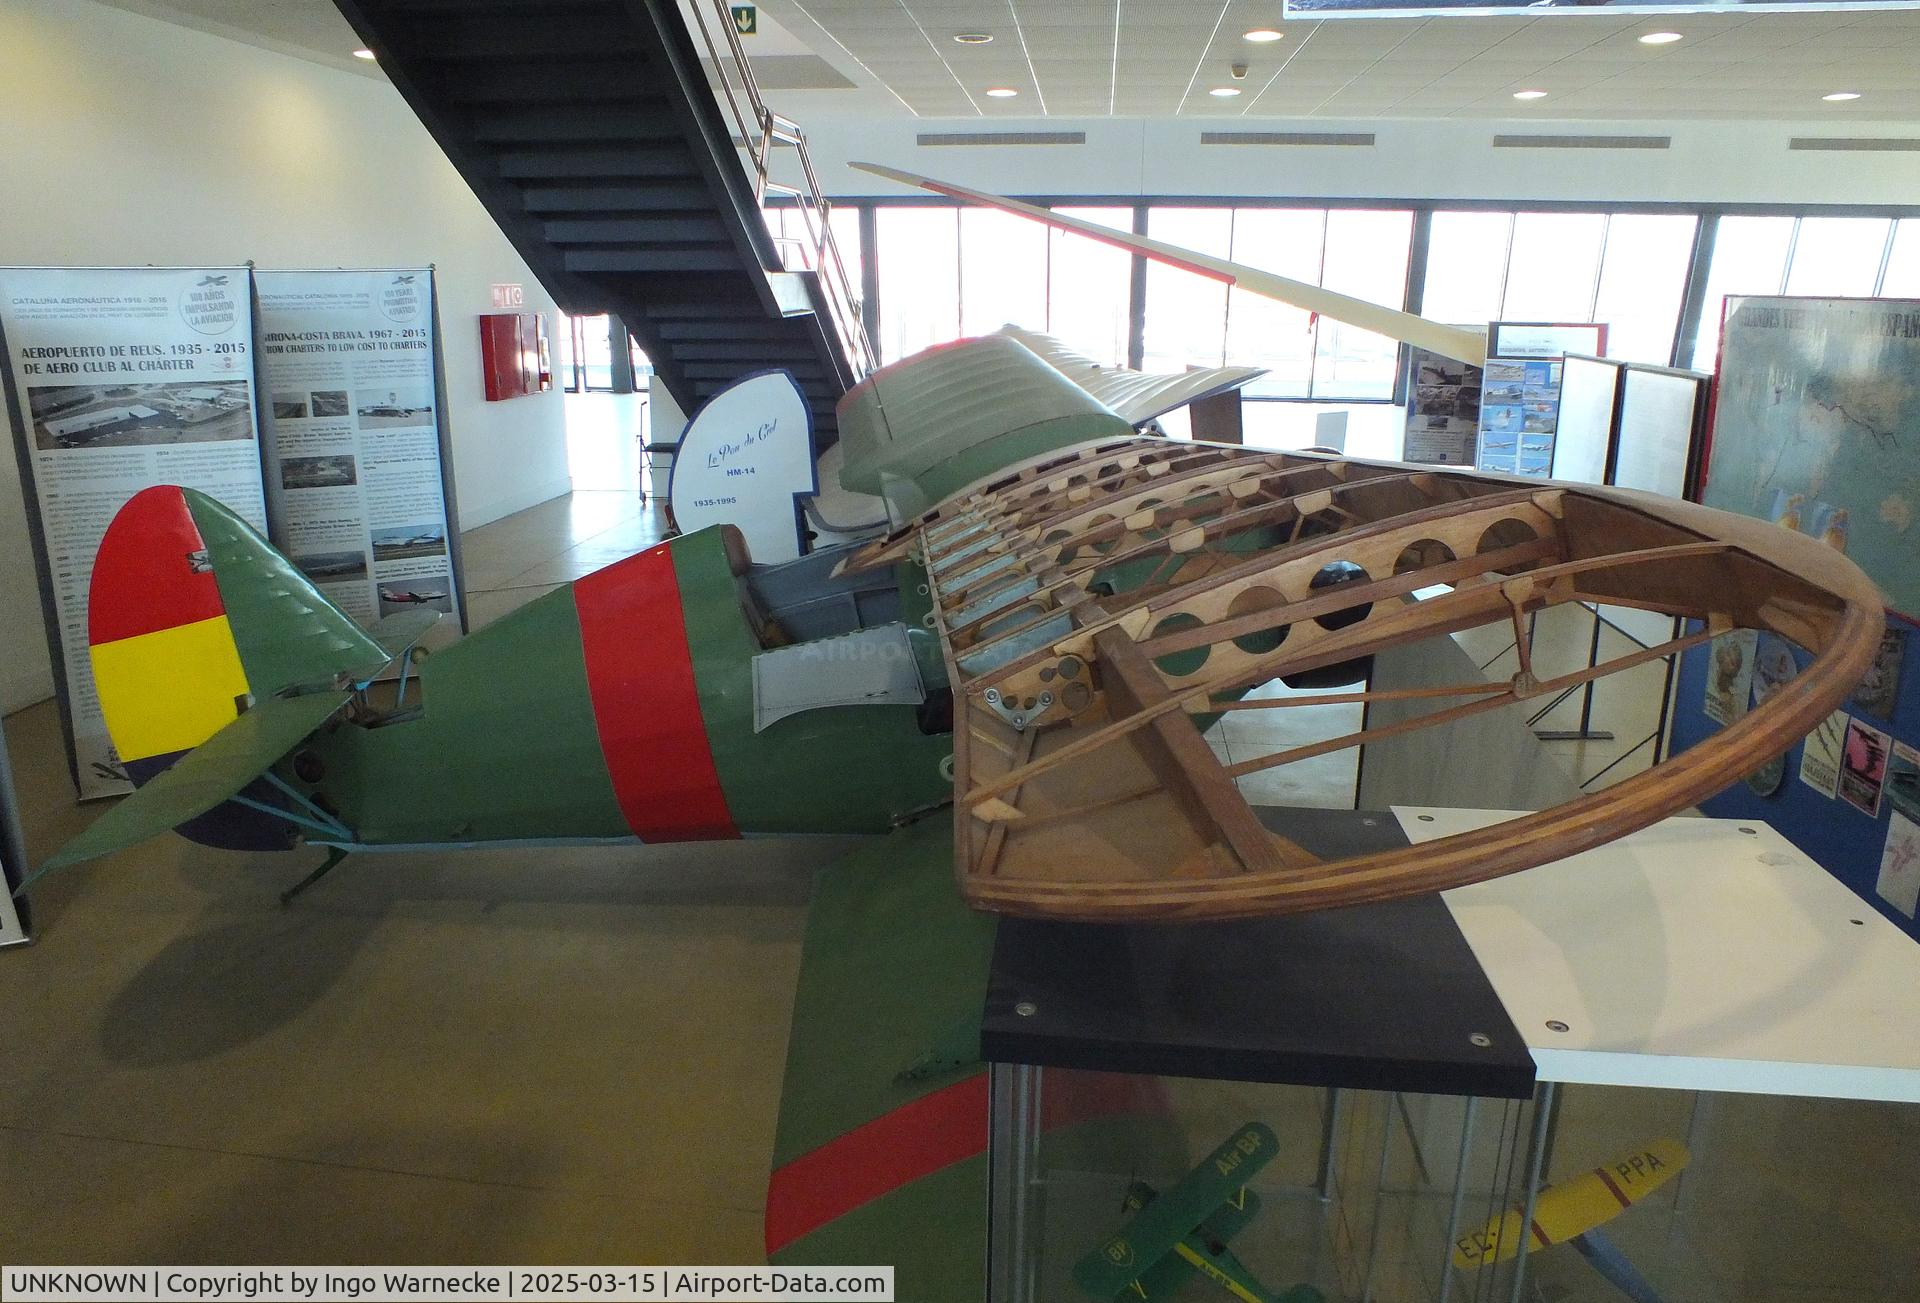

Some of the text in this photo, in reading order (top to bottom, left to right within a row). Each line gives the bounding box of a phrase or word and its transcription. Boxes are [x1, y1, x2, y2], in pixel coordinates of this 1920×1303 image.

[369, 330, 393, 339] 1967
[402, 329, 426, 338] 2015
[21, 346, 106, 359] AEROPUERTO
[109, 345, 127, 357] DE
[130, 344, 166, 357] REUS.
[170, 343, 202, 355] 1935
[214, 342, 246, 354] 2015
[357, 341, 376, 351] COST
[378, 341, 389, 350] TO
[390, 340, 428, 350] CHARTERS
[23, 362, 43, 375] DE
[46, 362, 79, 374] AERO
[82, 360, 117, 373] CLUB
[120, 360, 136, 372] AL
[726, 467, 756, 477] HM-14
[693, 497, 737, 507] 1935-1995
[1615, 1151, 1665, 1185] PPA
